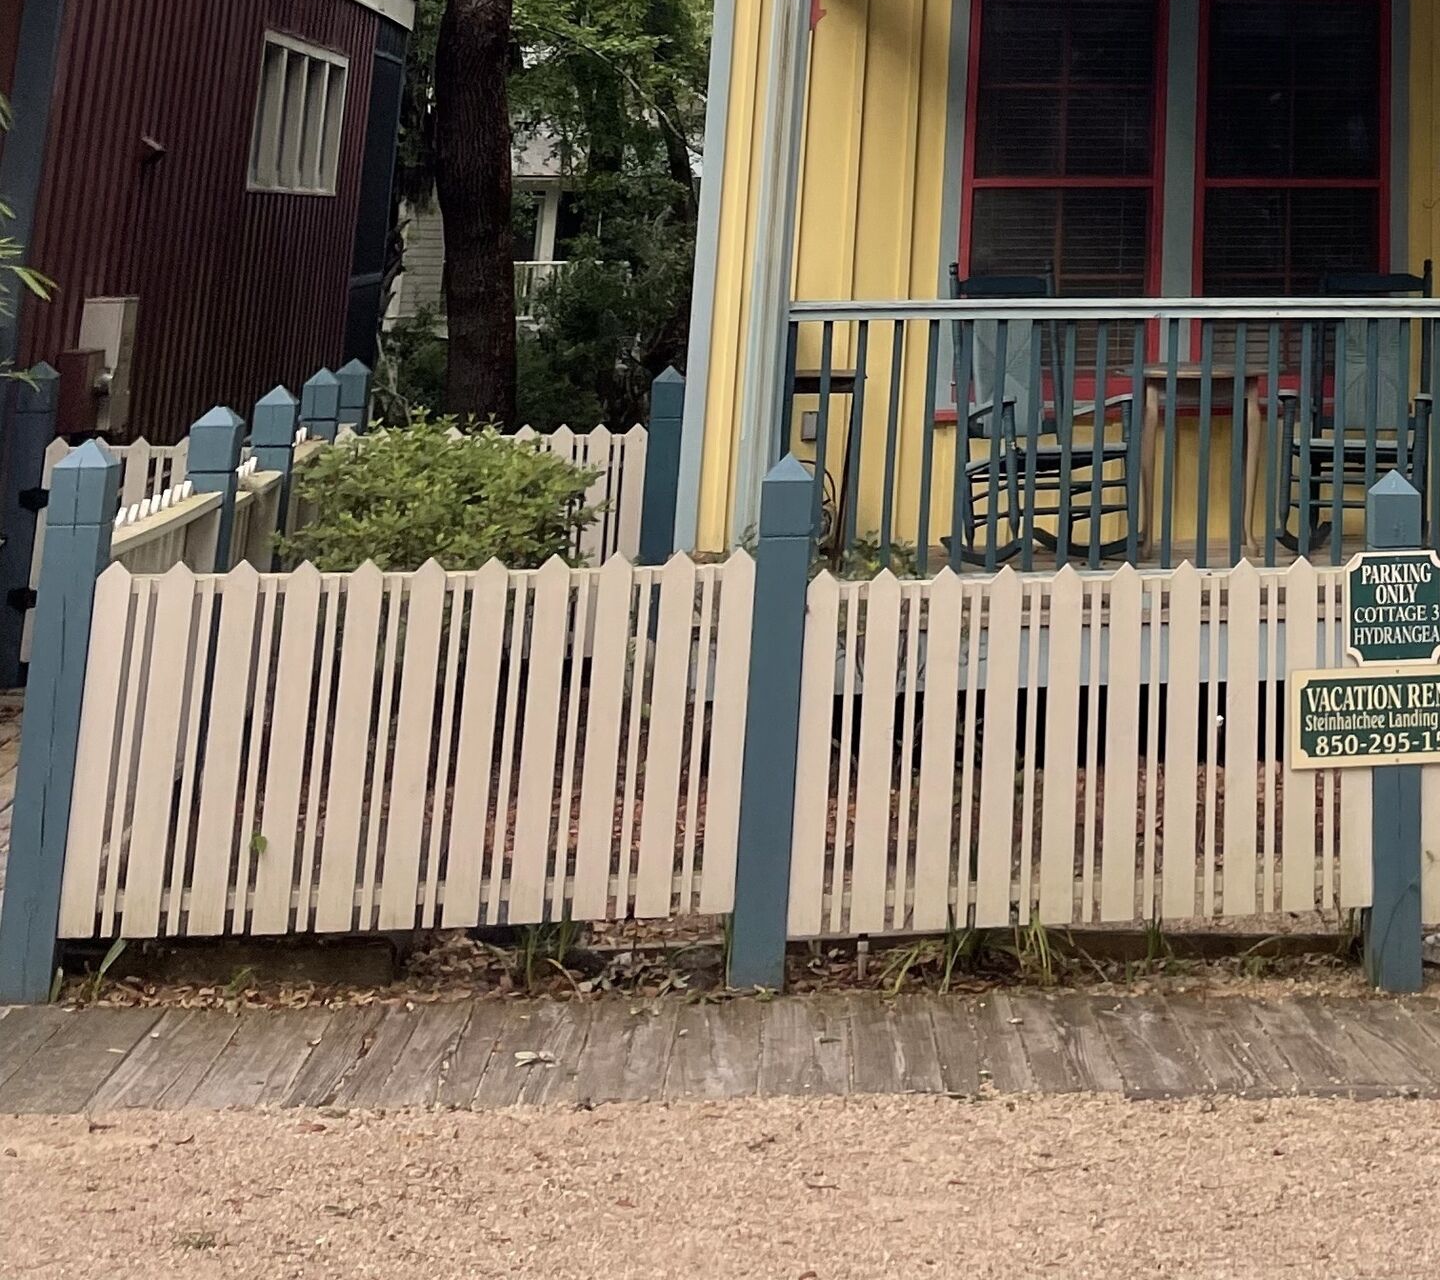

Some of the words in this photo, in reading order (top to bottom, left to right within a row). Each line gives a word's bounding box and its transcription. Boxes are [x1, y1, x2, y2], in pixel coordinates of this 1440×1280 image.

[1361, 563, 1432, 584] PARKING
[1375, 584, 1418, 604] ONLY
[1354, 605, 1428, 623] COTTAGE
[1431, 604, 1440, 620] 3
[1354, 625, 1440, 645] HYDRANGEA
[1306, 684, 1402, 712] VACATION
[1305, 711, 1386, 732] Steinhatchee
[1389, 709, 1438, 730] Landing
